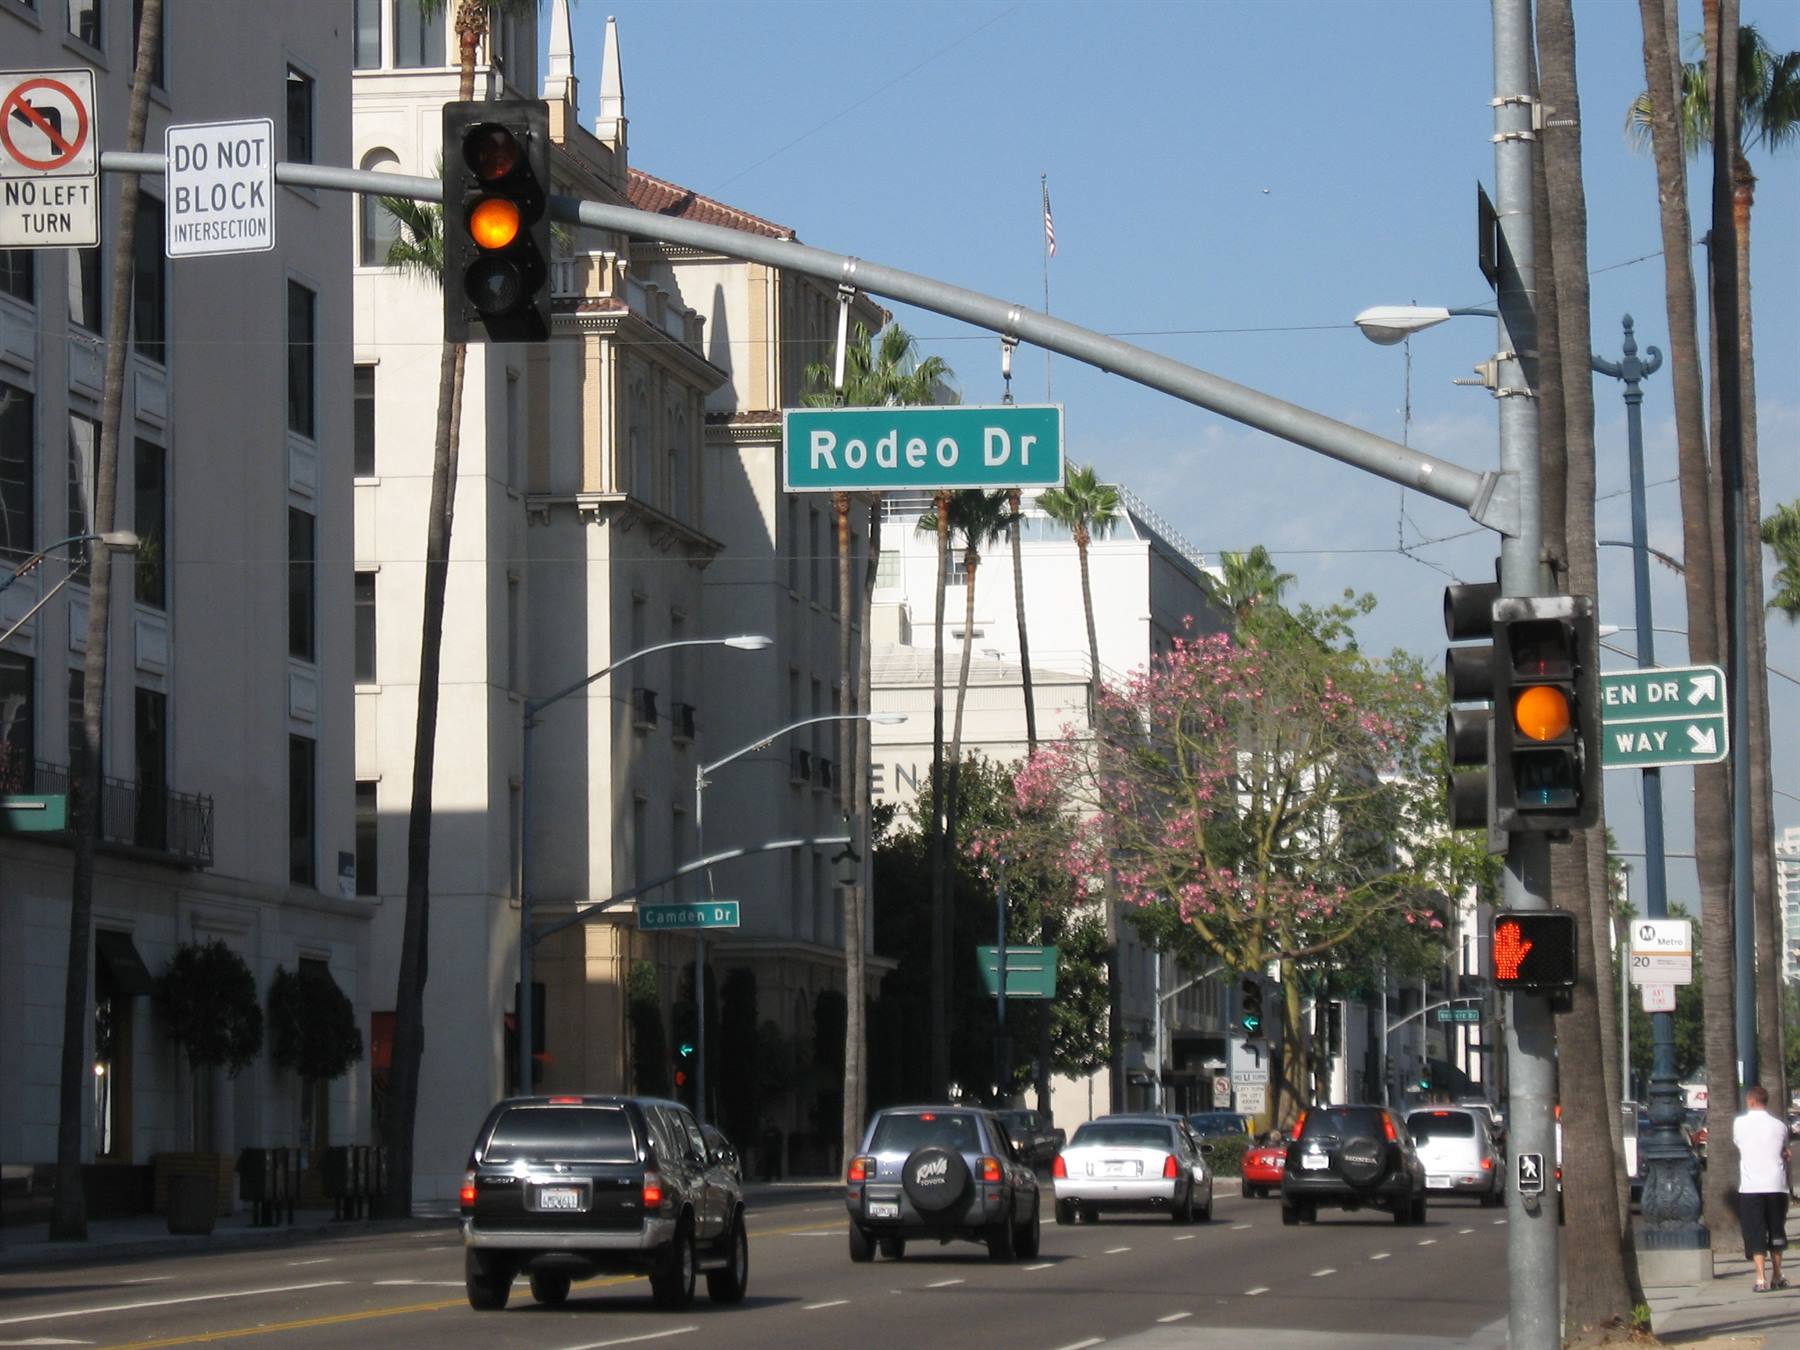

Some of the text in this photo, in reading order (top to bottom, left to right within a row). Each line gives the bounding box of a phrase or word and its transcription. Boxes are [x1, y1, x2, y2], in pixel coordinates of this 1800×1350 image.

[175, 138, 265, 172] DO NOT
[6, 181, 89, 206] NO LEFT
[175, 181, 265, 214] BLOCK
[22, 213, 71, 233] TURN
[174, 217, 266, 243] INTERSECTION
[810, 427, 1037, 470] Rodeo Dr
[1601, 682, 1680, 705] EN DR
[1616, 731, 1668, 753] WAY
[646, 907, 731, 924] Camden Dr
[1658, 938, 1683, 946] Metro
[1633, 956, 1650, 968] 20
[1243, 1073, 1250, 1081] U
[1344, 1154, 1378, 1165] HONDA
[920, 1178, 946, 1187] TOYOTA
